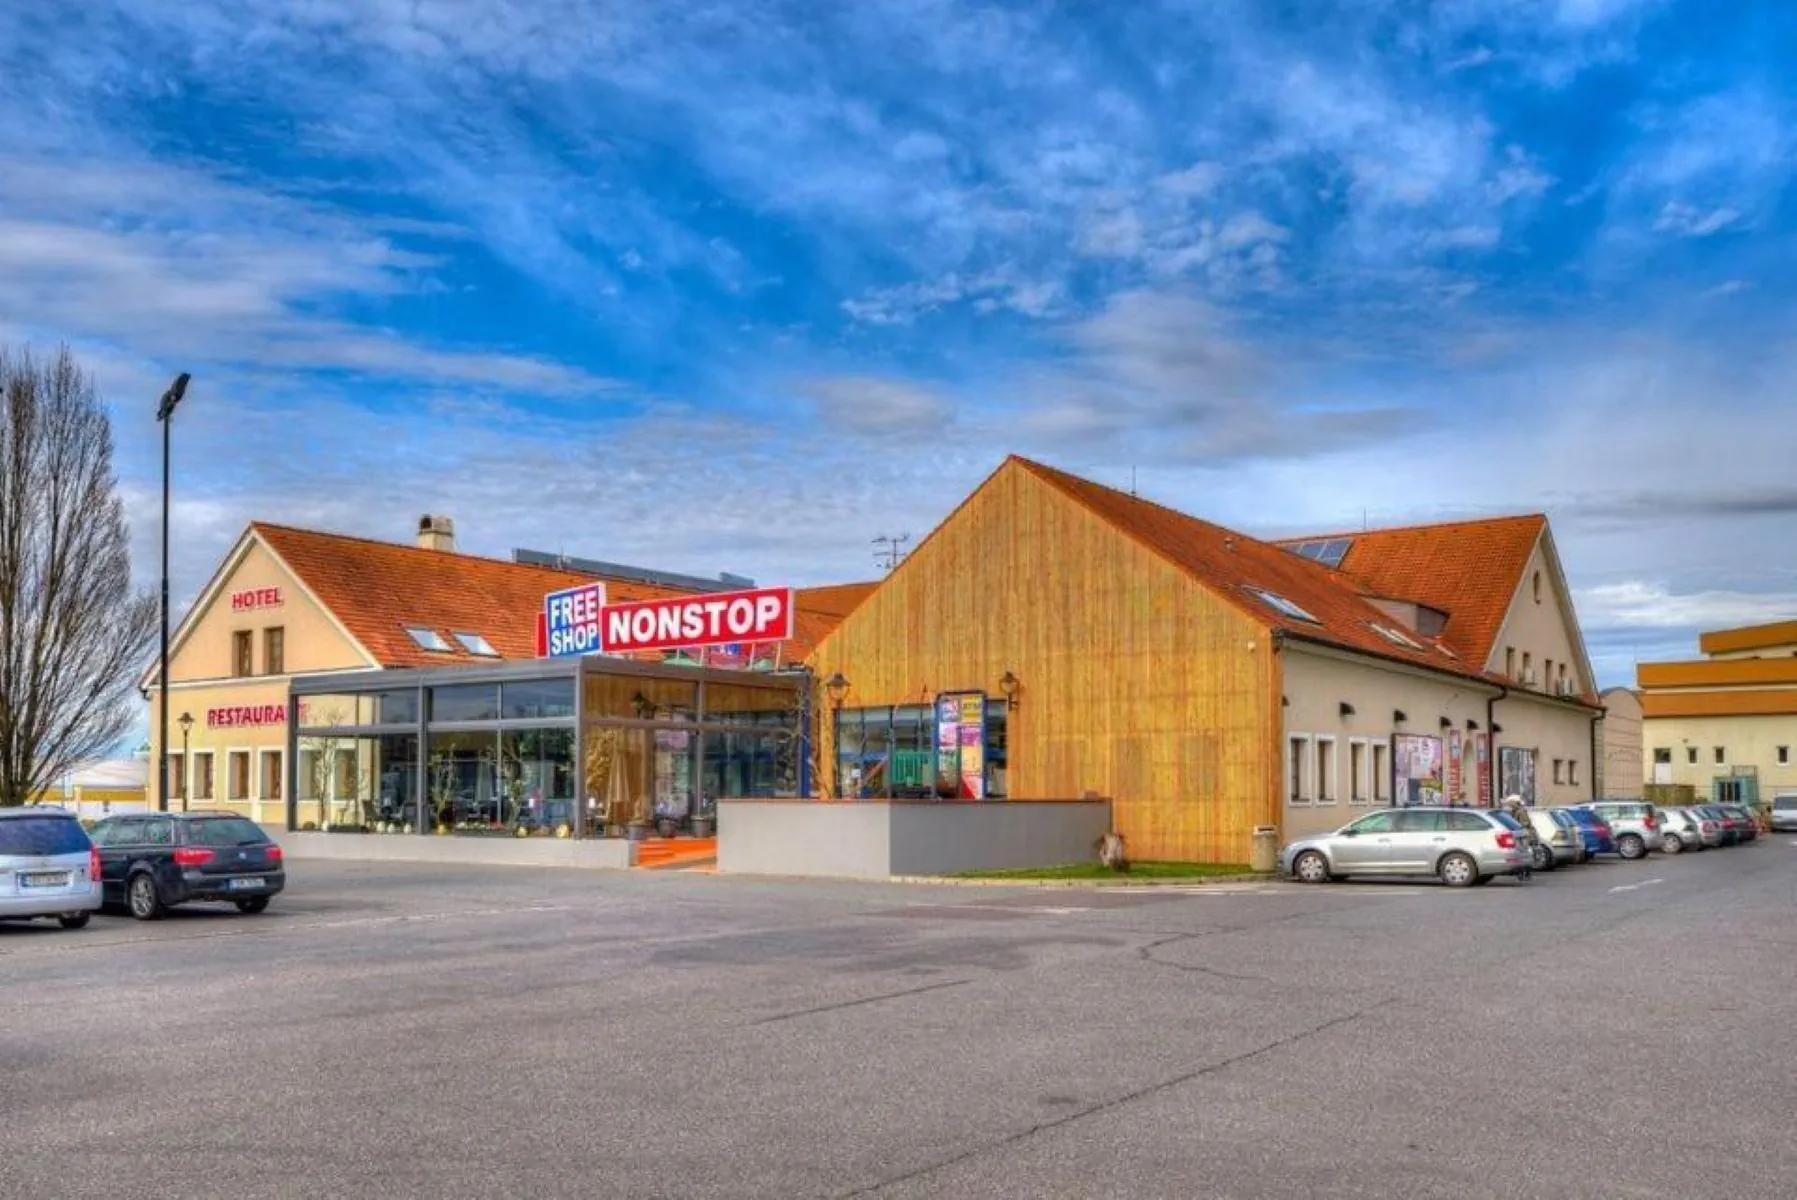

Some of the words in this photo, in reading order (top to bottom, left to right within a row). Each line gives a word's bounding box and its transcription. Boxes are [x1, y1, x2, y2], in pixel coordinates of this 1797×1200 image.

[232, 588, 281, 609] HOTEL
[550, 590, 598, 629] FREE
[608, 595, 781, 645] NONSTOP
[550, 623, 598, 657] SHOP
